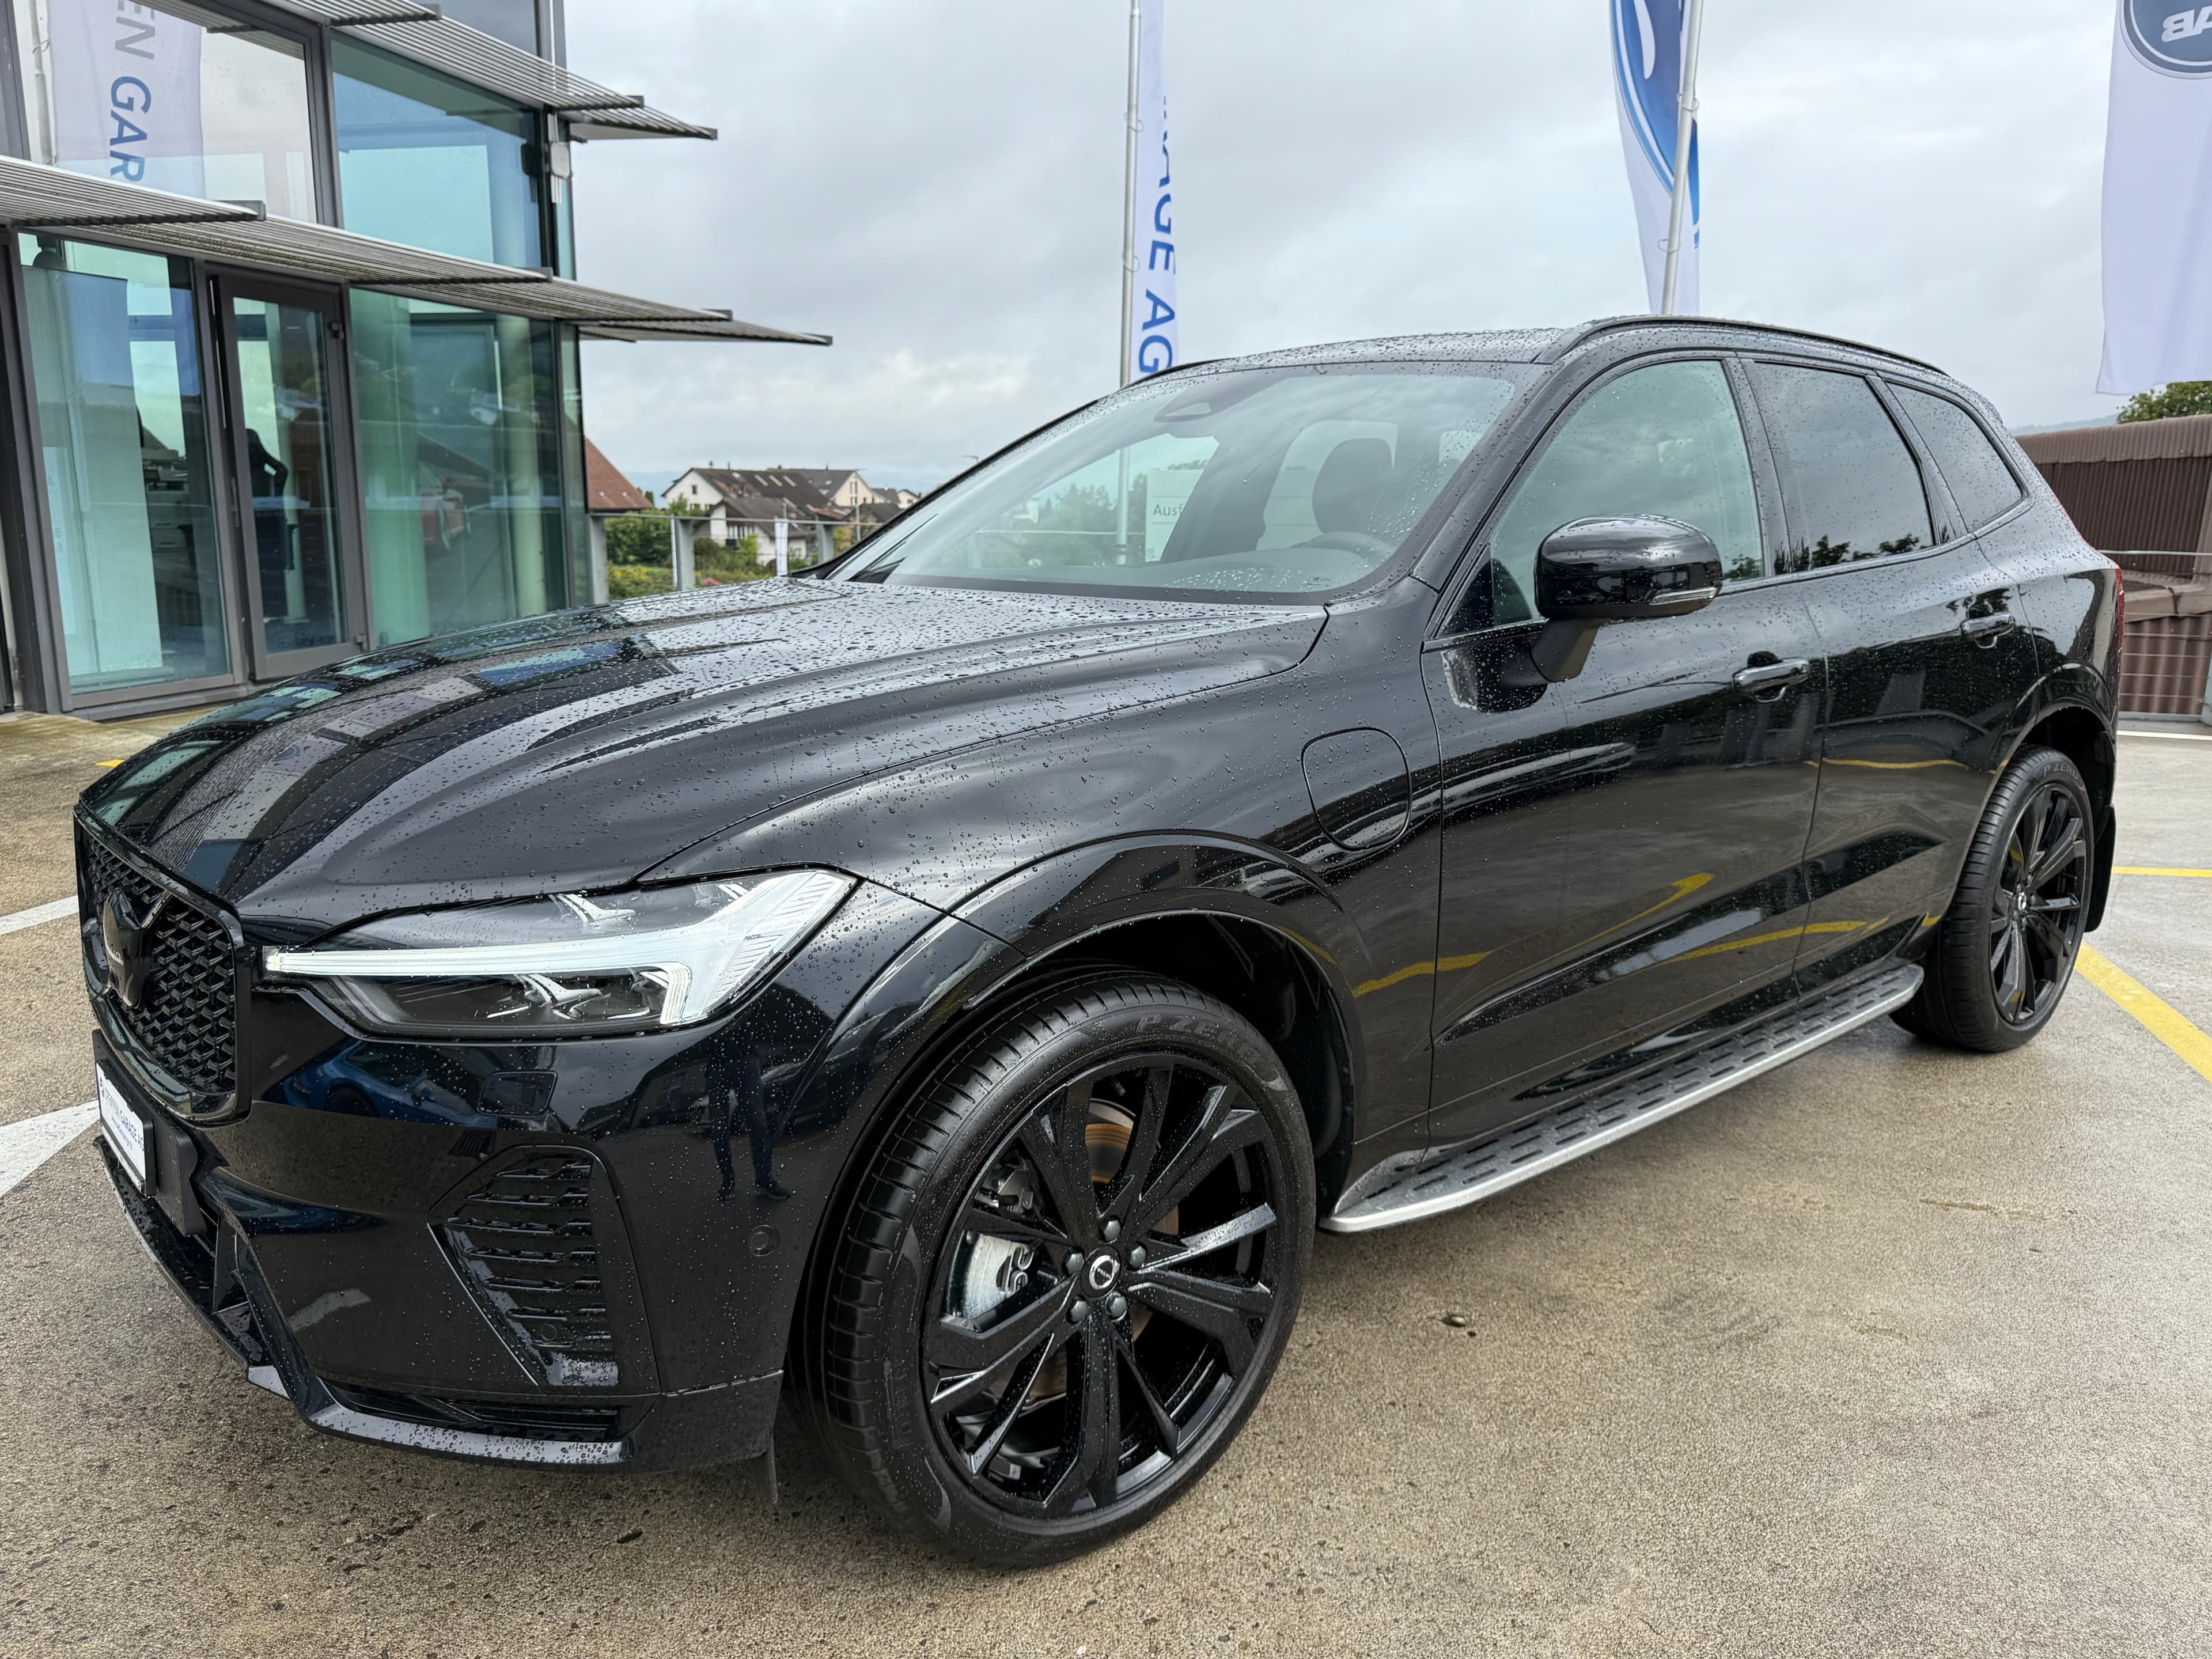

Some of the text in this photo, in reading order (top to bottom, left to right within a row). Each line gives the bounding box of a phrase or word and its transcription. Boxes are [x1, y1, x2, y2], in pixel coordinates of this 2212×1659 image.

[109, 75, 152, 183] GAR
[1138, 288, 1176, 373] AG
[2043, 762, 2079, 780] P ZERO
